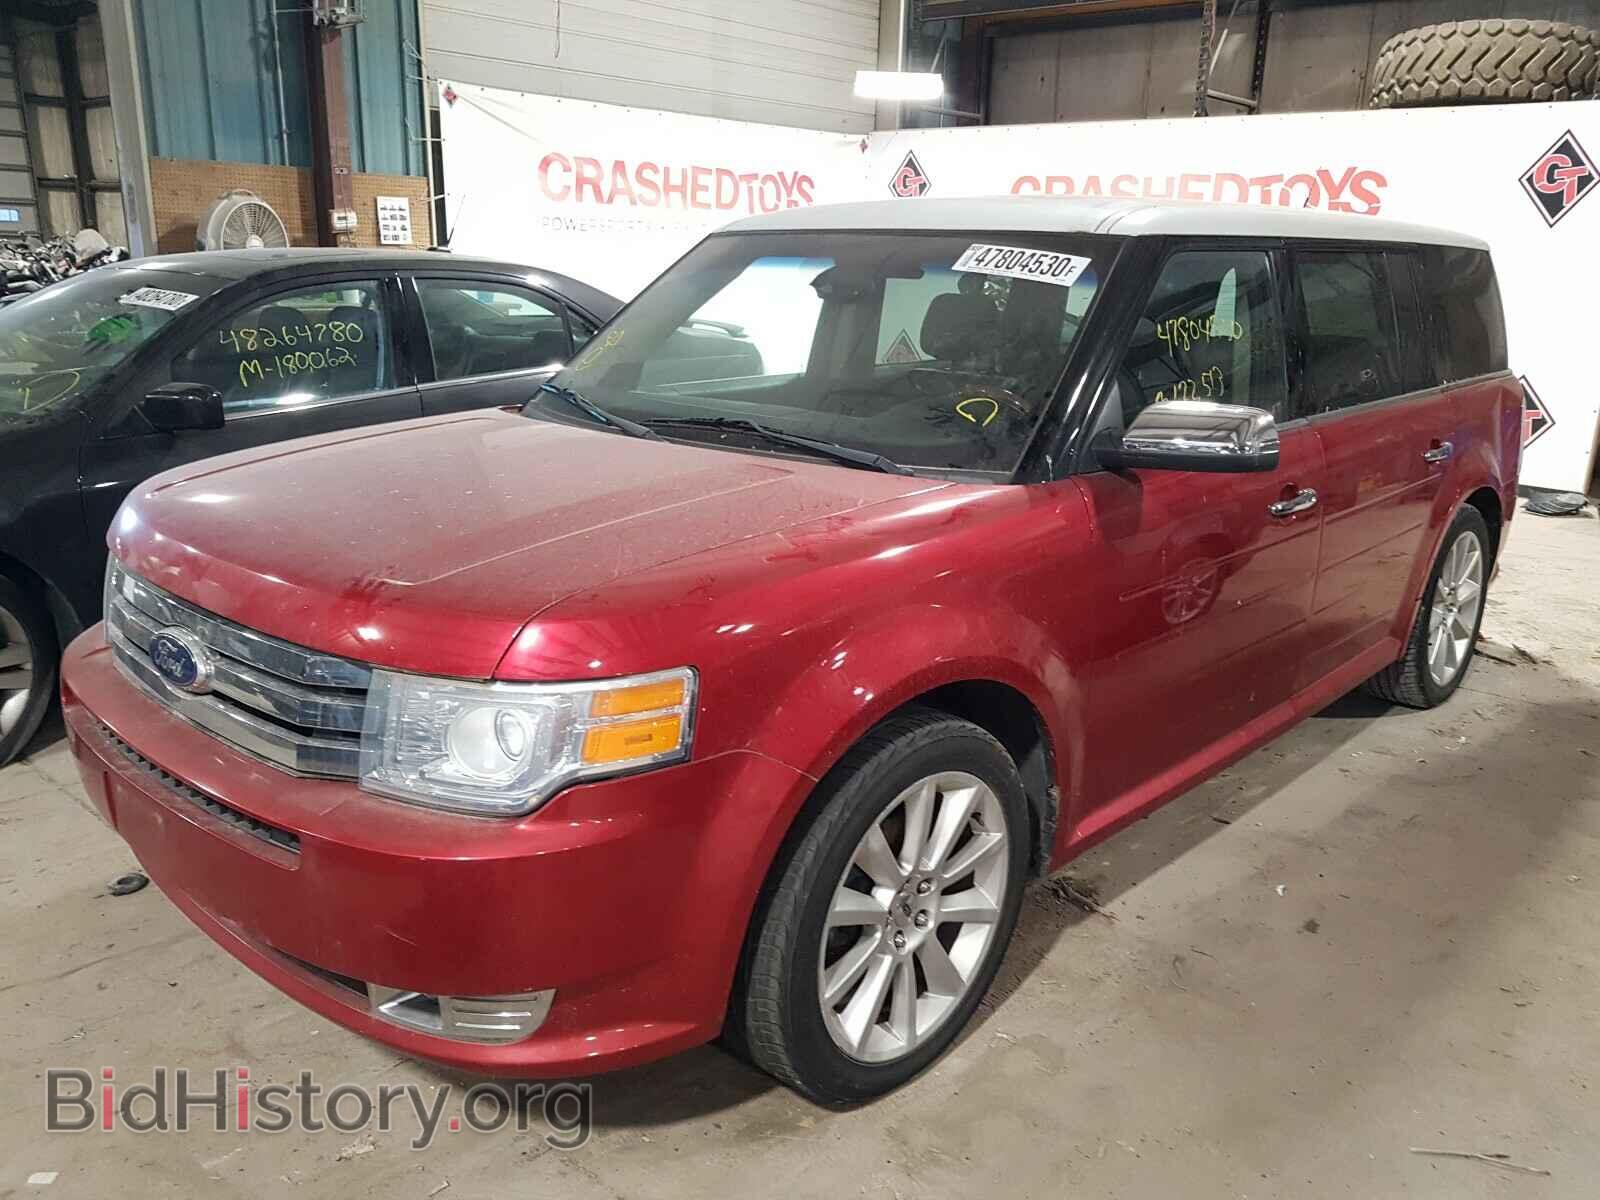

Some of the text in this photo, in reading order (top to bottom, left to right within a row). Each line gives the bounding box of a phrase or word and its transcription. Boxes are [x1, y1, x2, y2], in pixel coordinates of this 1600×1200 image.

[538, 152, 815, 215] CRASHEDTOYS
[219, 321, 364, 353] 48264780
[155, 639, 186, 678] Ford
